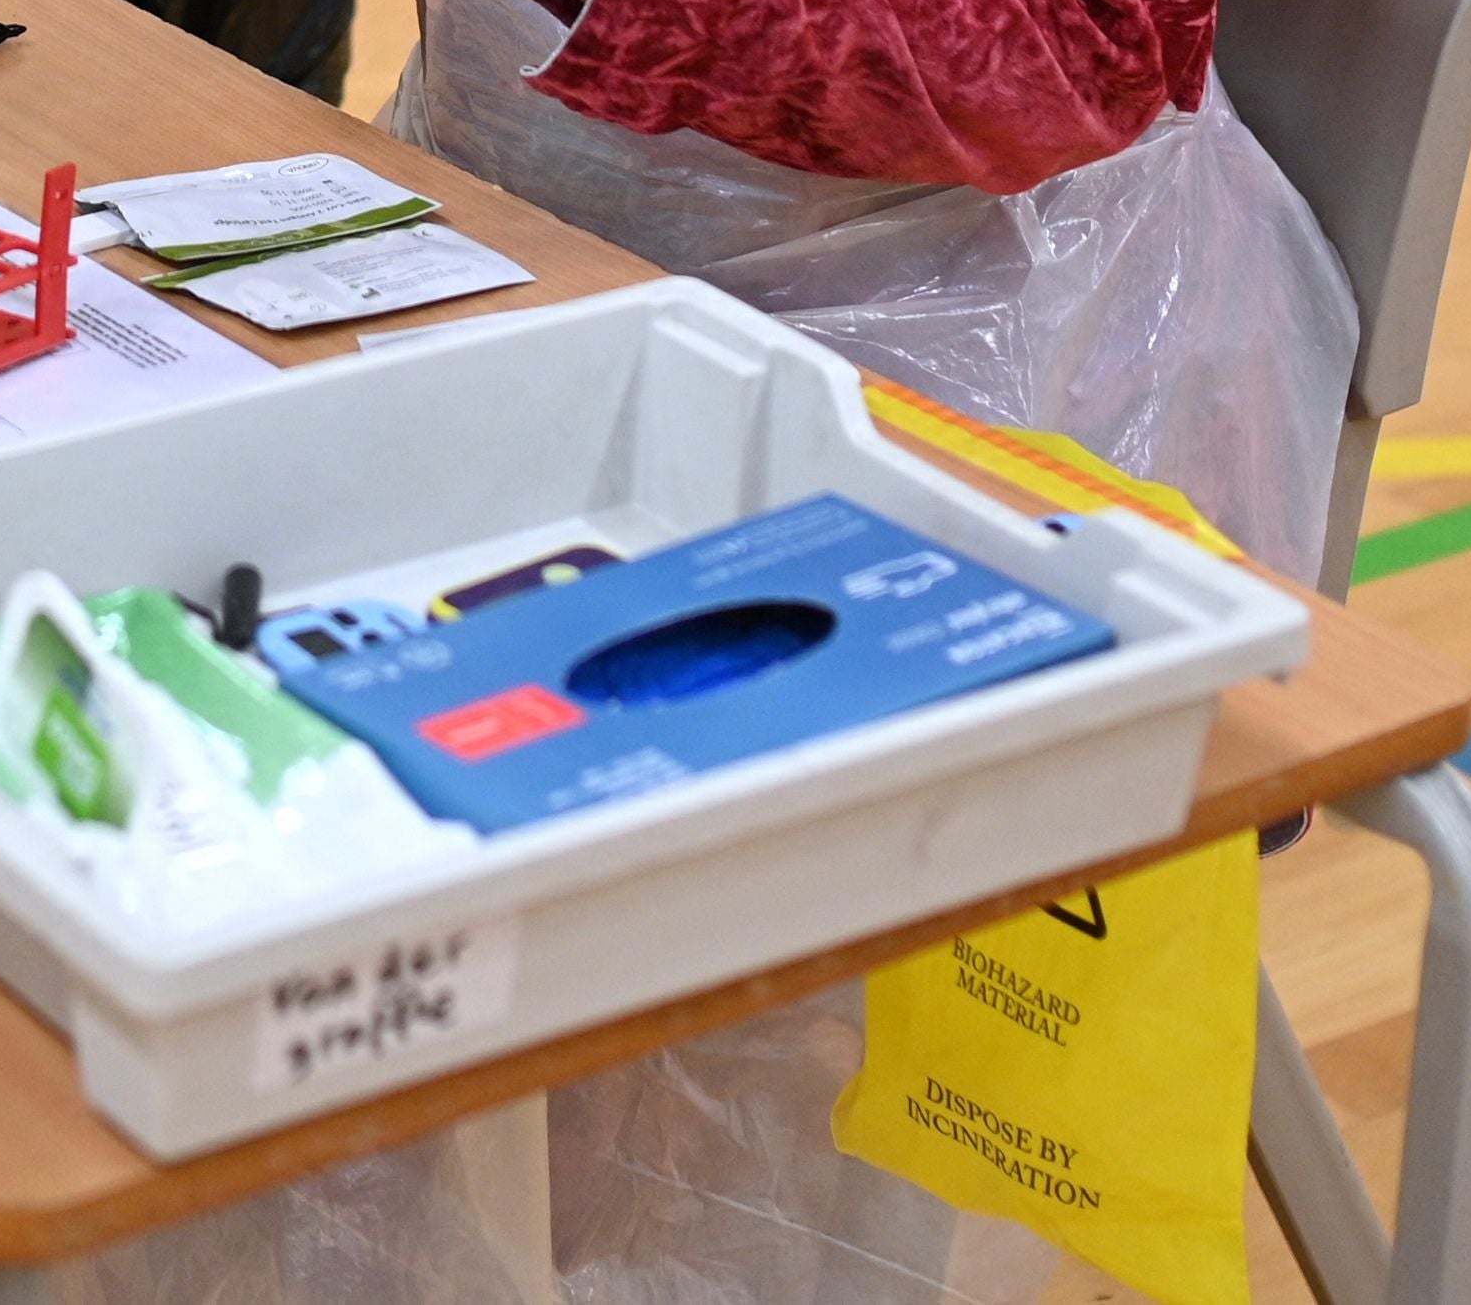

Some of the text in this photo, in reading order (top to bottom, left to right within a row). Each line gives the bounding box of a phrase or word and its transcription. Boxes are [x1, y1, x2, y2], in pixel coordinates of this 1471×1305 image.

[952, 934, 1081, 1026] BIOHAZARD
[956, 967, 1067, 1047] MATERIAL
[906, 1094, 1101, 1208] INCINERATION
[925, 1077, 1078, 1170] DISPOSE BY
